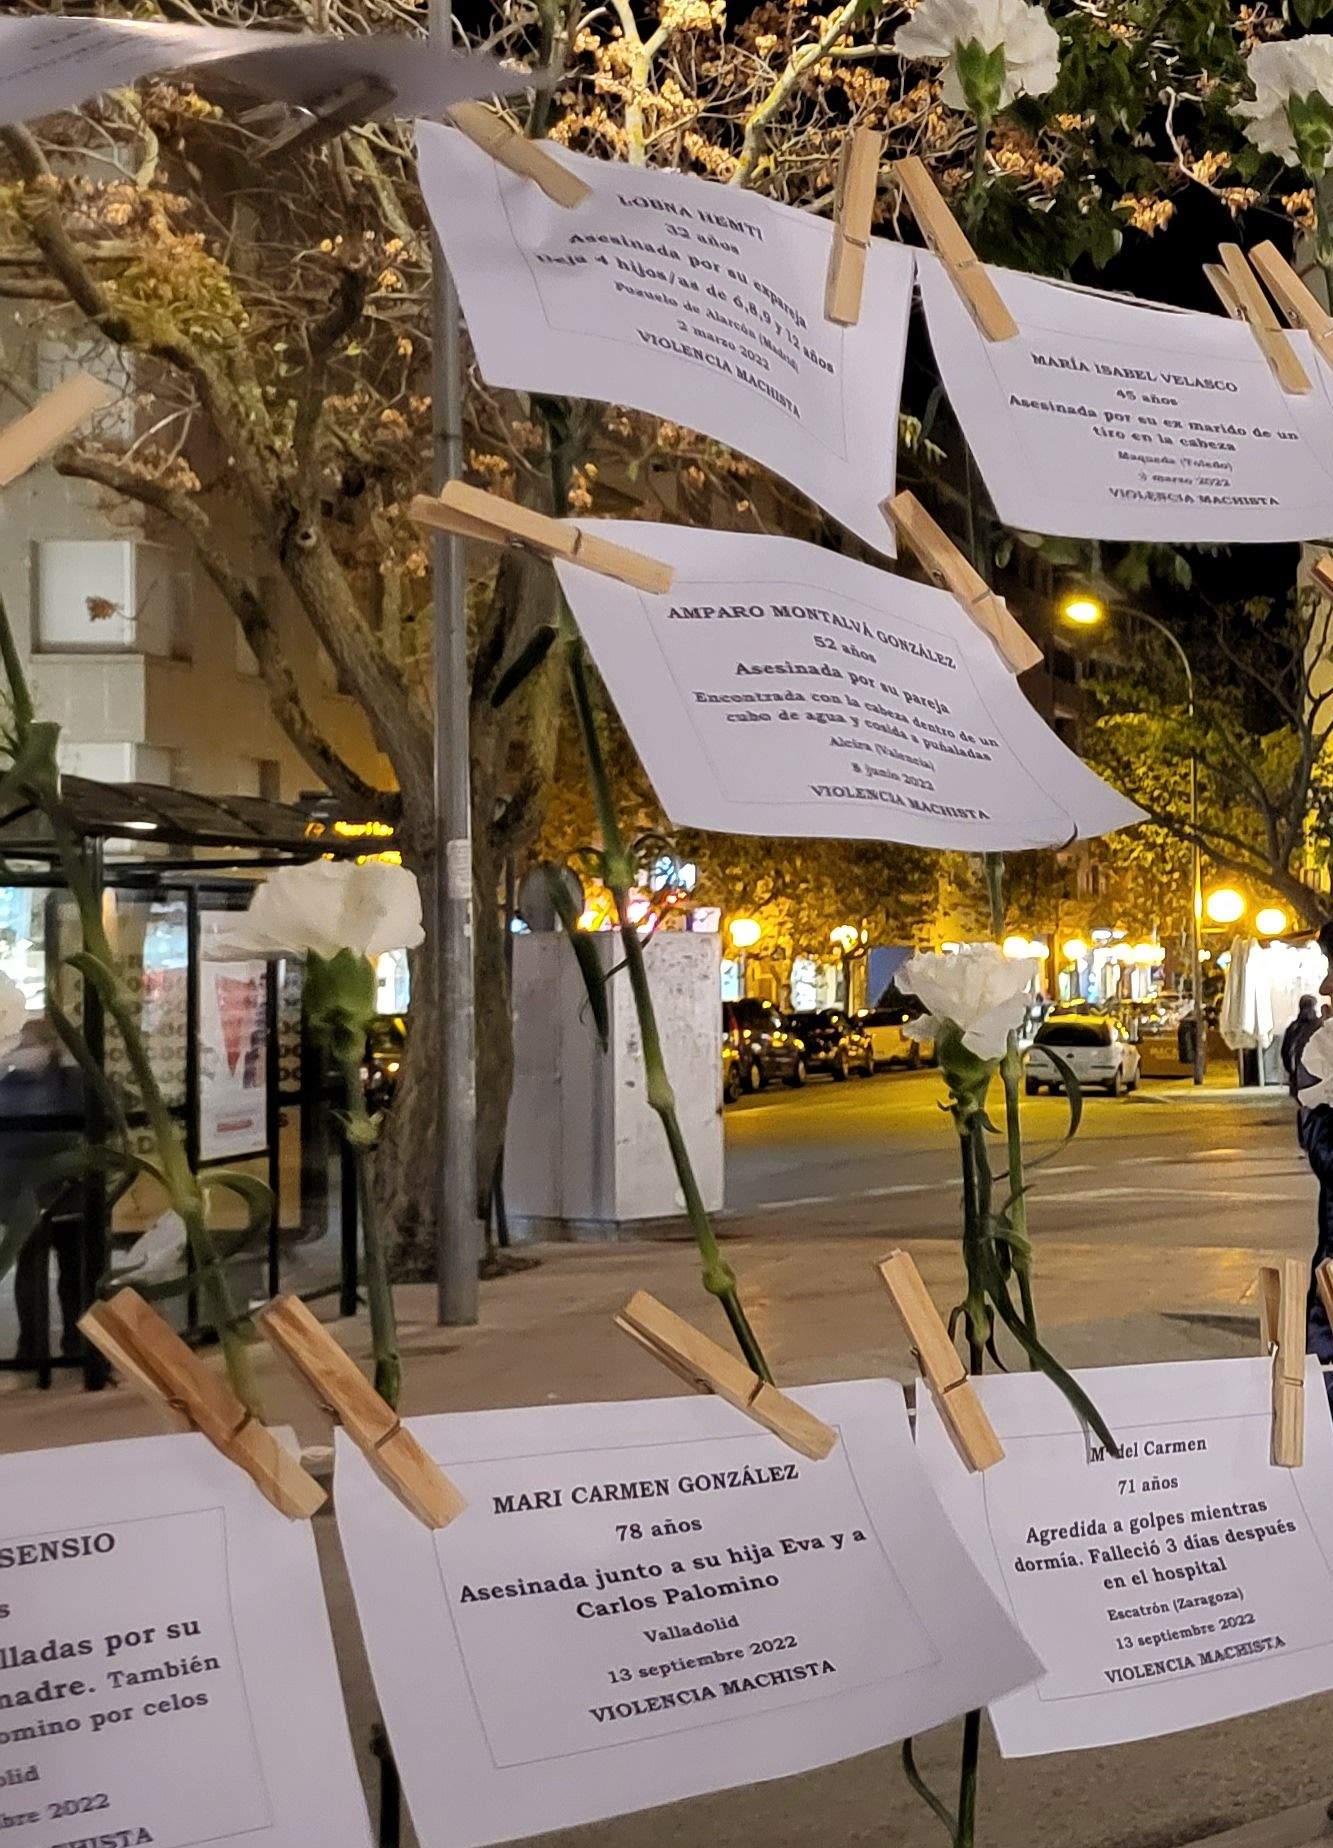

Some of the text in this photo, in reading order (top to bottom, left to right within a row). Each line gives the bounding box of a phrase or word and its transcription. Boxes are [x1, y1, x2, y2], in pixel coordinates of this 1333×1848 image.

[665, 223, 739, 254] 32 años
[569, 234, 806, 329] Asesinada por su expareja
[616, 257, 833, 373] hijos/as de años
[692, 327, 769, 371] marzo 2022
[637, 329, 800, 418] VIOLENCIA MACHISTA
[1031, 354, 1237, 392] MARÍA ISABEL VELASCO
[1010, 395, 1246, 435] Asesinada marido
[1142, 394, 1178, 405] años
[1109, 488, 1194, 503] VIOLENCIA
[668, 606, 956, 669] AMPARO GONZÁLEZ
[814, 636, 876, 663] 52 años
[736, 661, 950, 714] Asesinada por su pareja
[692, 690, 976, 743] Encontrada la cabeza dentro de
[806, 712, 991, 761] agua puñaladas
[874, 744, 935, 772] (Valencia)
[865, 764, 934, 791] junio 2022
[811, 786, 990, 819] VIOLENCIA MACHISTA
[1144, 1440, 1206, 1455] Carmen
[493, 1465, 798, 1514] MARI CARMEN GONZÁLEZ
[1118, 1476, 1178, 1495] 71 años
[616, 1519, 702, 1541] 78 años
[1027, 1502, 1267, 1546] Agredida golpes mientras
[1015, 1519, 1296, 1572] dormía. Falleció días después
[461, 1538, 825, 1603] Asesinada junto su hija Eva
[1104, 1557, 1227, 1589] en el hospital
[577, 1575, 778, 1618] Carlos Palomino
[1107, 1588, 1243, 1621] Escatrón (Zaragoza)
[105, 1621, 201, 1657] por su
[643, 1615, 739, 1642] Valladolid
[1116, 1613, 1255, 1649] 13 septiembre 2022
[107, 1656, 220, 1688] También
[608, 1636, 797, 1683] 13 septiembre 2022
[1104, 1636, 1286, 1683] VIOLENCIA MACHISTA
[589, 1661, 836, 1722] VIOLENCIA MACHISTA
[90, 1694, 208, 1732] por celos
[48, 1794, 110, 1819] 2022
